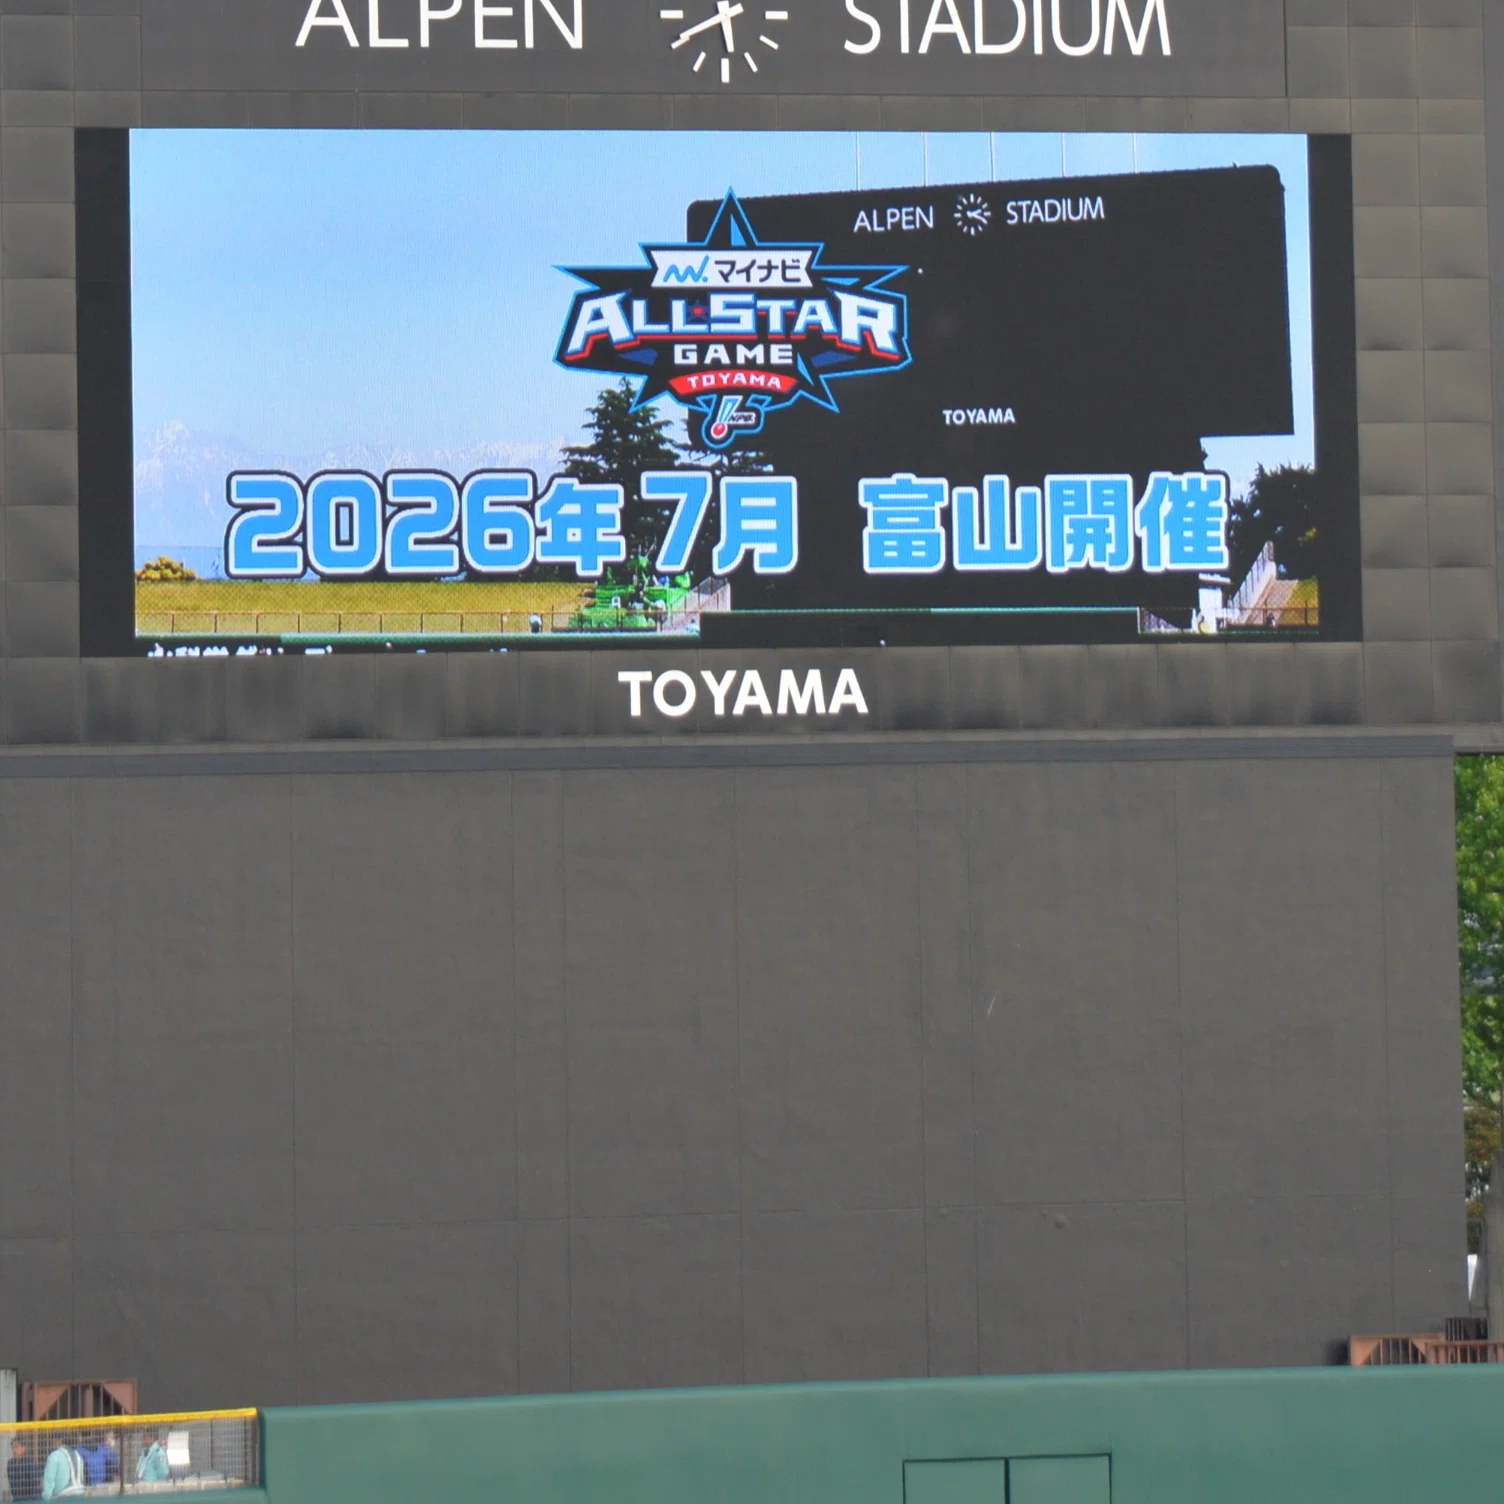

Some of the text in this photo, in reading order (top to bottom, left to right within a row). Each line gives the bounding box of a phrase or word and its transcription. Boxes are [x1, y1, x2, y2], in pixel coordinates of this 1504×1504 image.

[853, 196, 1105, 233] ALPEN STADIUM
[714, 258, 801, 283] マイナビ
[673, 344, 793, 365] GAME
[687, 372, 782, 389] TOYAMA
[942, 407, 1016, 425] TOYAMA
[858, 471, 1230, 573] 富山開催
[617, 668, 869, 718] TOYAMA
